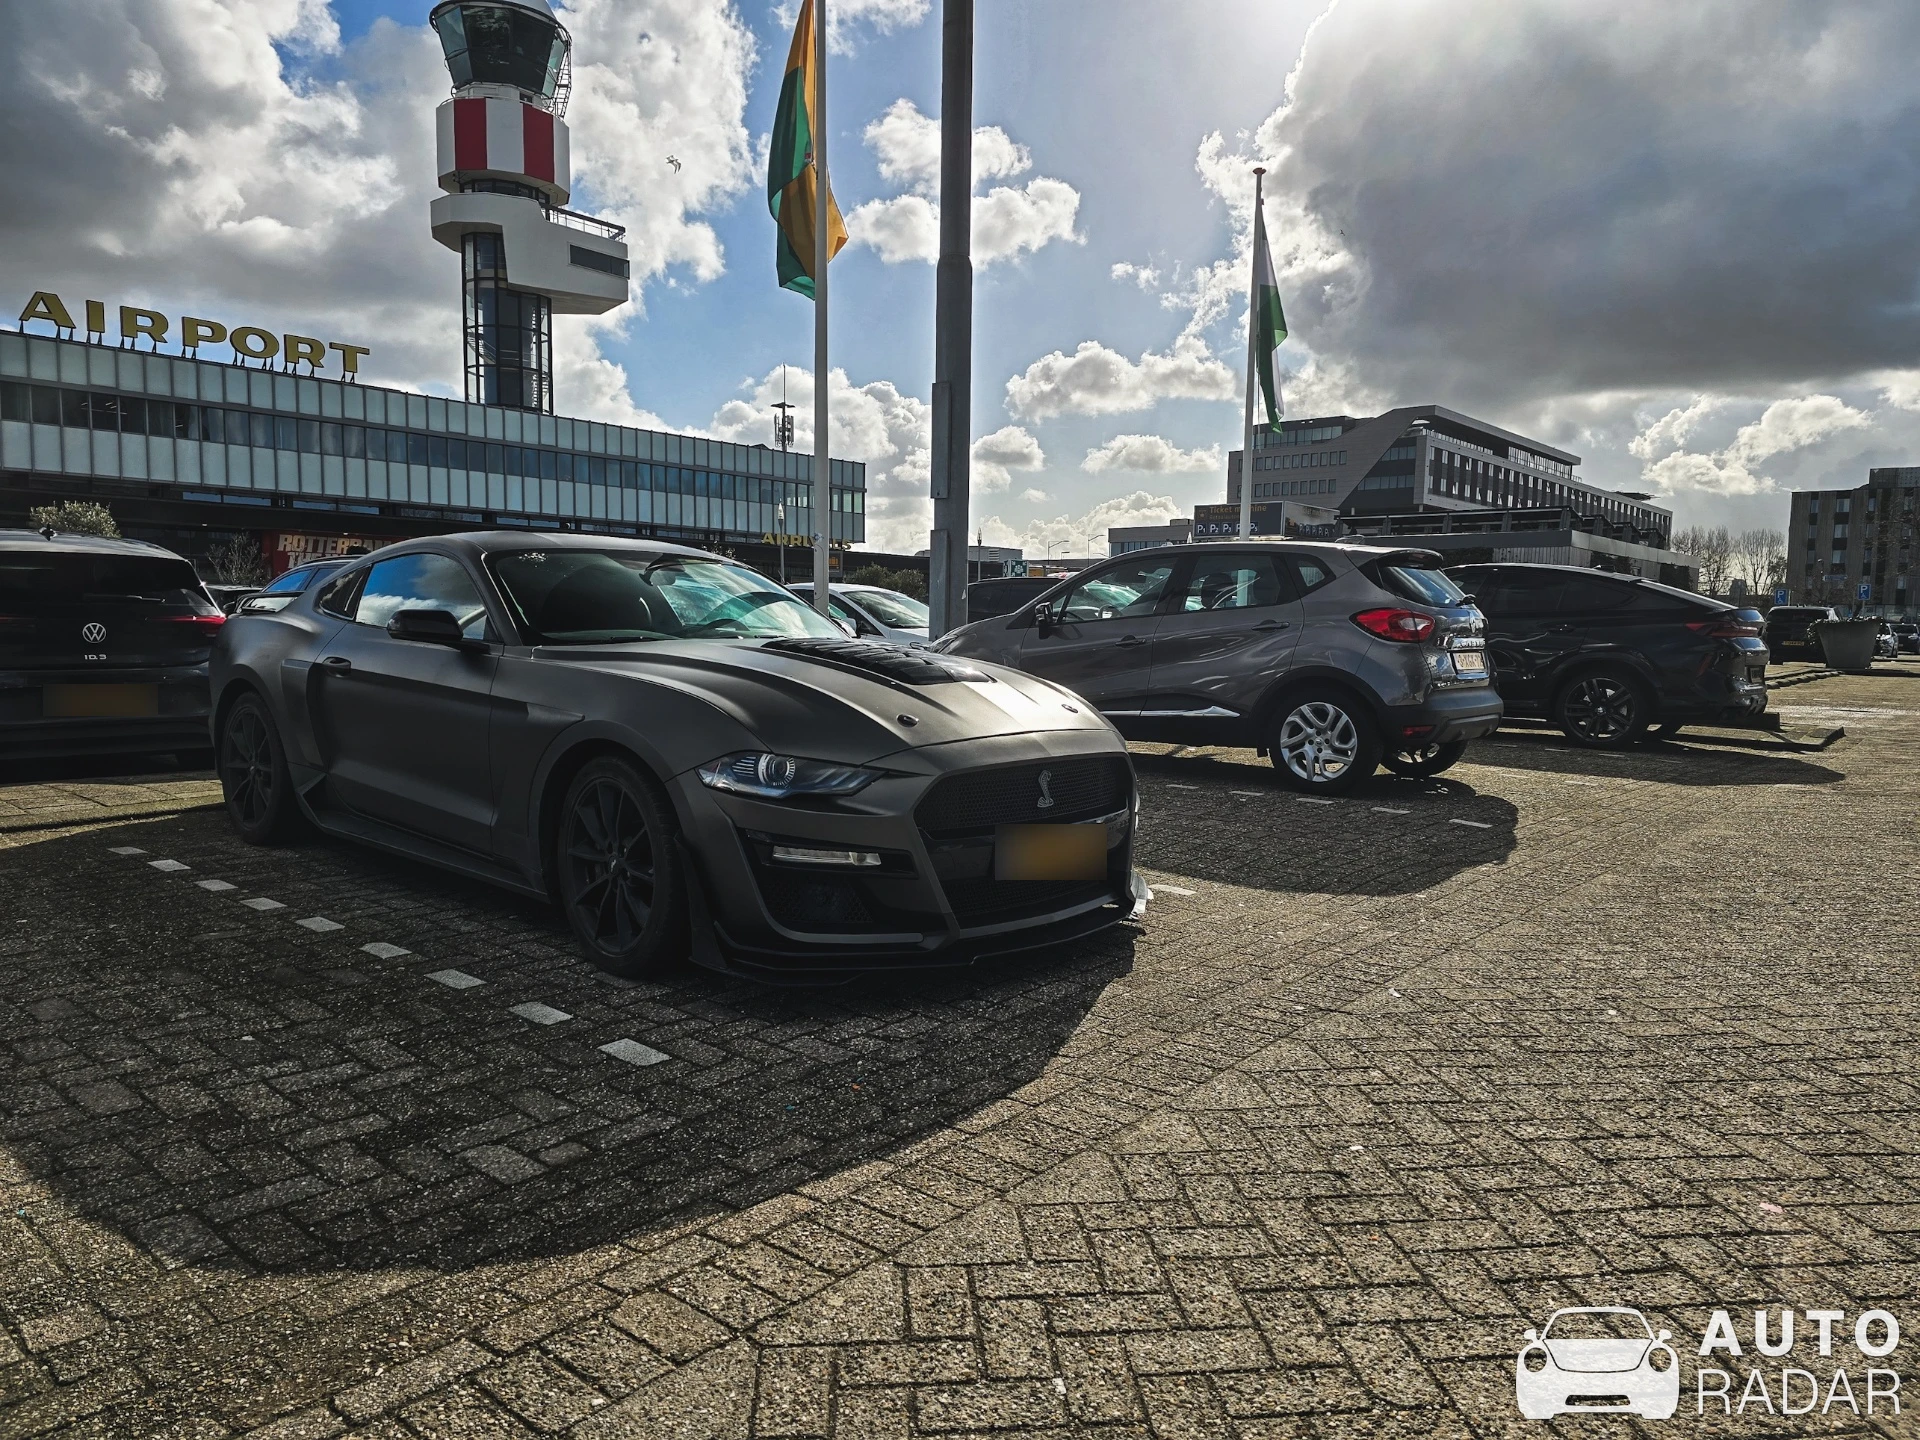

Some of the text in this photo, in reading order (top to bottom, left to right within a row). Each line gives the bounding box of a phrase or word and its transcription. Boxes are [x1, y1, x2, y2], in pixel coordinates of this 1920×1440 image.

[19, 291, 370, 373] AIRPORT
[1209, 504, 1267, 514] Ticket mhine
[762, 532, 852, 550] ARRILS
